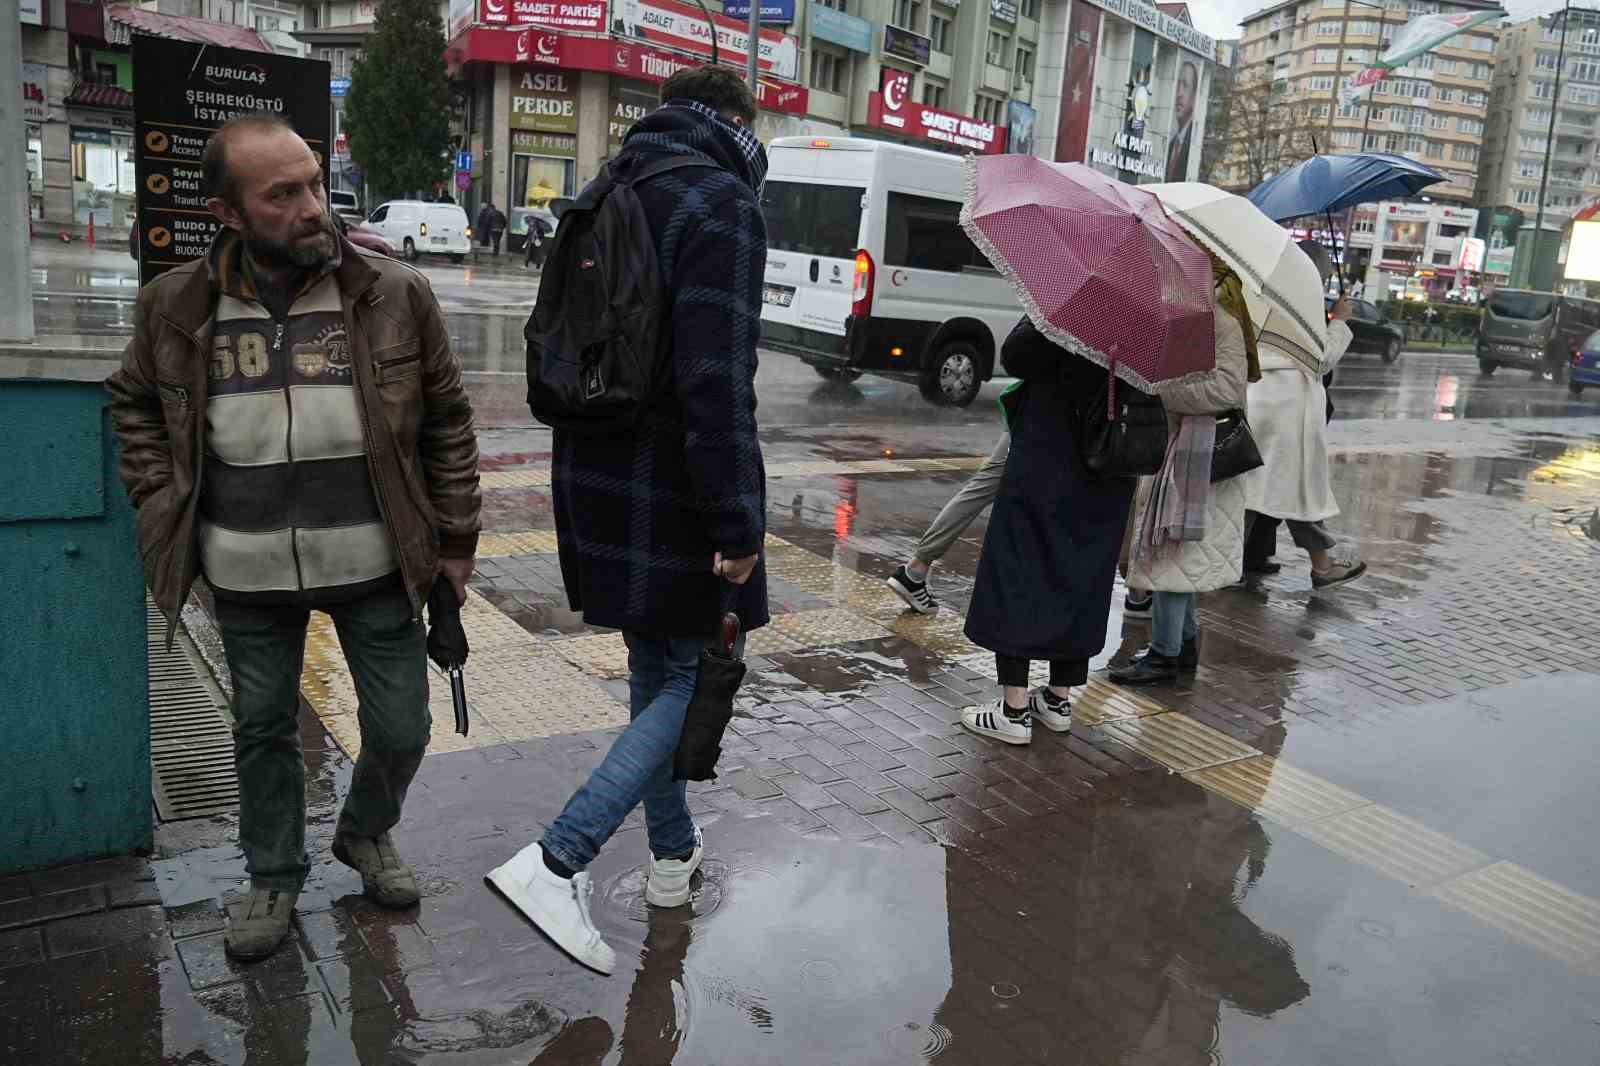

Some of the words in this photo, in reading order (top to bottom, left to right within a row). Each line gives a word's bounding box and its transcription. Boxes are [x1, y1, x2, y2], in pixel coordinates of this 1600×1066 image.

[513, 1, 557, 15] SAADET
[560, 4, 601, 18] PARTİSİ
[643, 11, 674, 30] ADALET
[205, 65, 266, 85] BURULAŞ
[521, 72, 567, 92] ASEL
[186, 89, 284, 113] ŞEHREKÜSTÜ
[512, 96, 574, 117] PERDE
[171, 134, 204, 146] Trene
[173, 180, 200, 190] Ofisi
[174, 194, 199, 206] Travel
[174, 220, 206, 231] BUDO
[174, 232, 200, 243] Bilet
